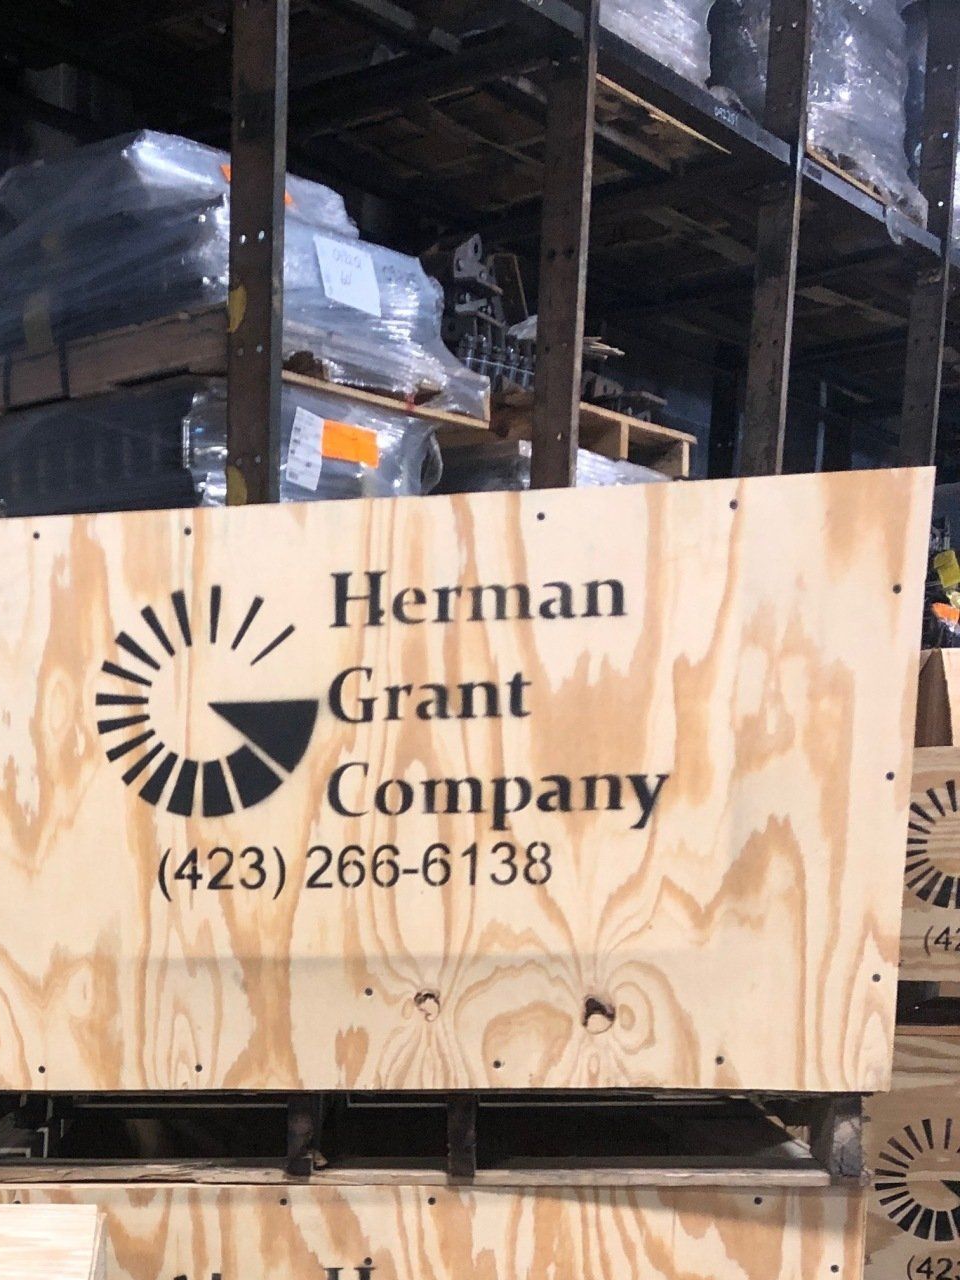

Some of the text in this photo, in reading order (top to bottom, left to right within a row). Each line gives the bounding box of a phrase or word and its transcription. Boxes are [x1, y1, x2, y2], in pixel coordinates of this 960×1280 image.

[330, 571, 627, 627] Herman
[329, 666, 531, 724] Grant
[328, 762, 669, 831] Company
[158, 842, 553, 901] (423) 266-6138
